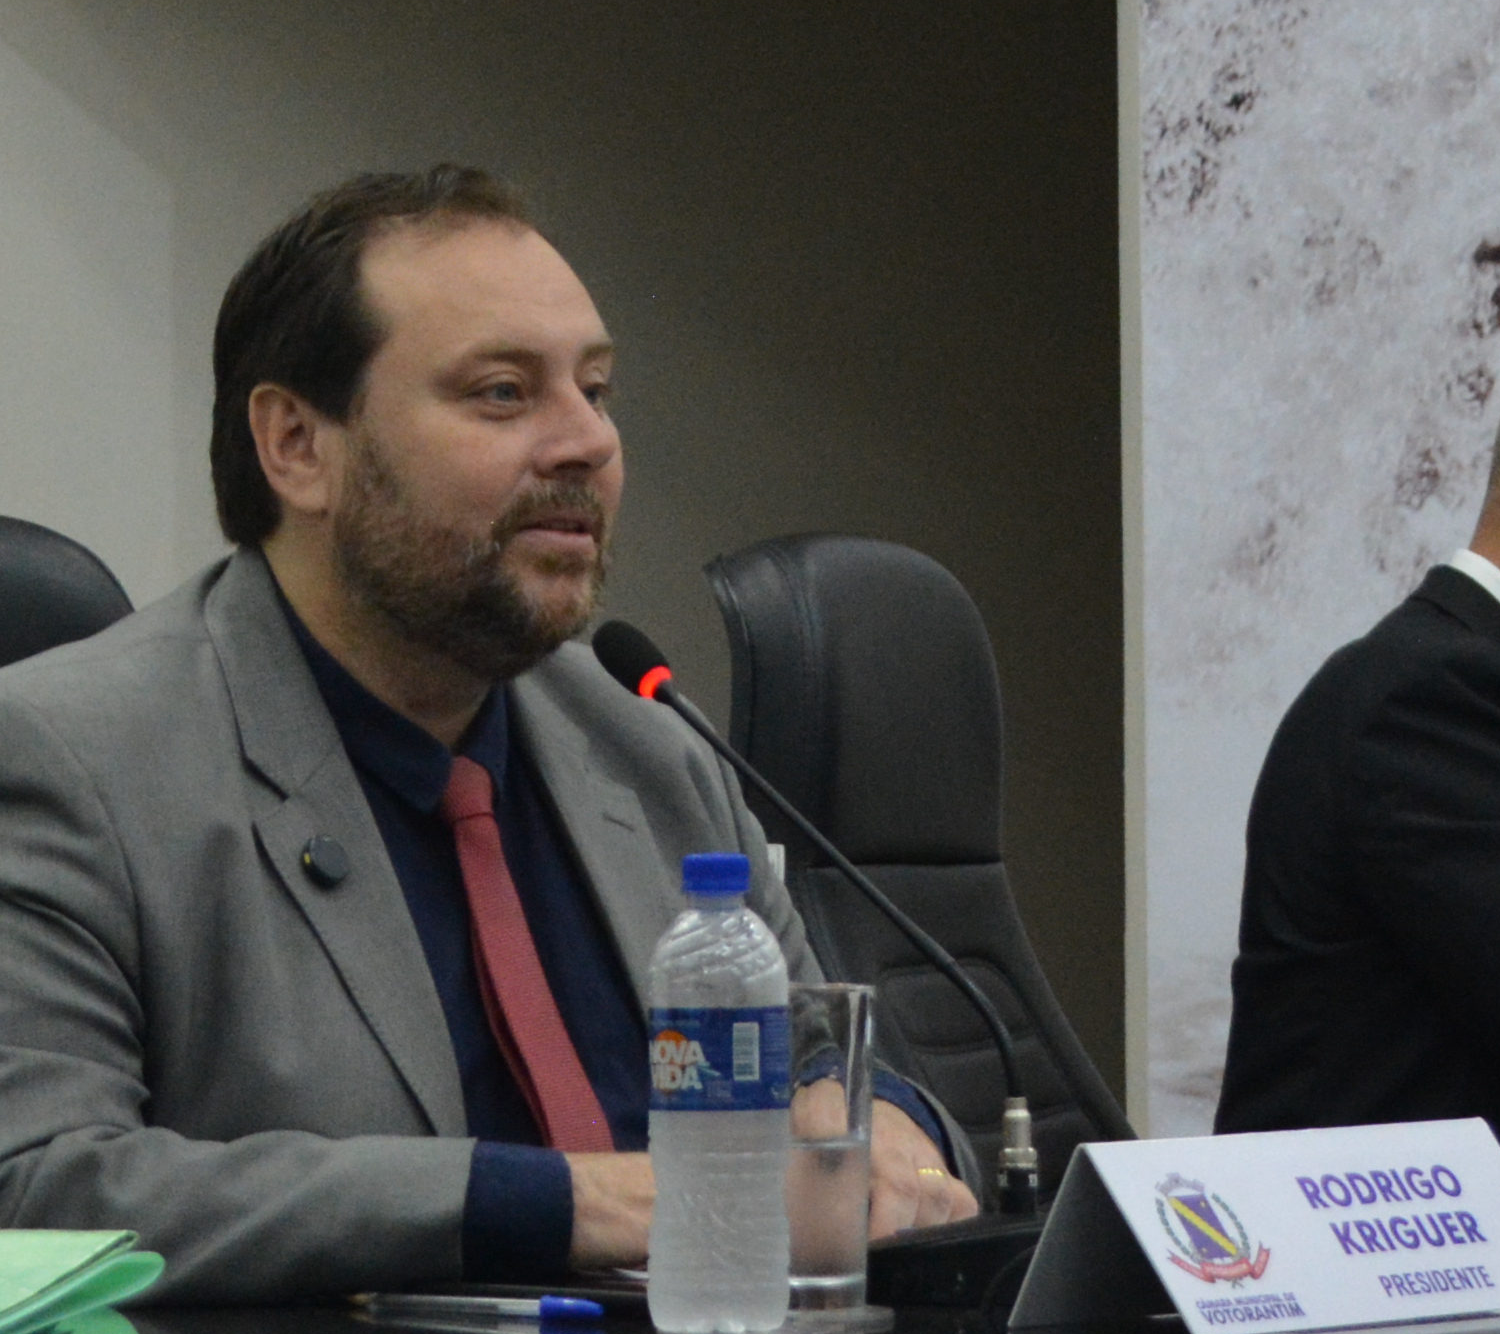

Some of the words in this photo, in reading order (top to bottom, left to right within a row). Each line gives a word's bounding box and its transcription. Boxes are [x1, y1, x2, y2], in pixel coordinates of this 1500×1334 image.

[1294, 1164, 1462, 1209] RODRIGO
[1328, 1210, 1488, 1255] KRIGUER
[1378, 1265, 1496, 1298] PRESIDENTE
[1200, 1301, 1306, 1326] VOTORANTIM
